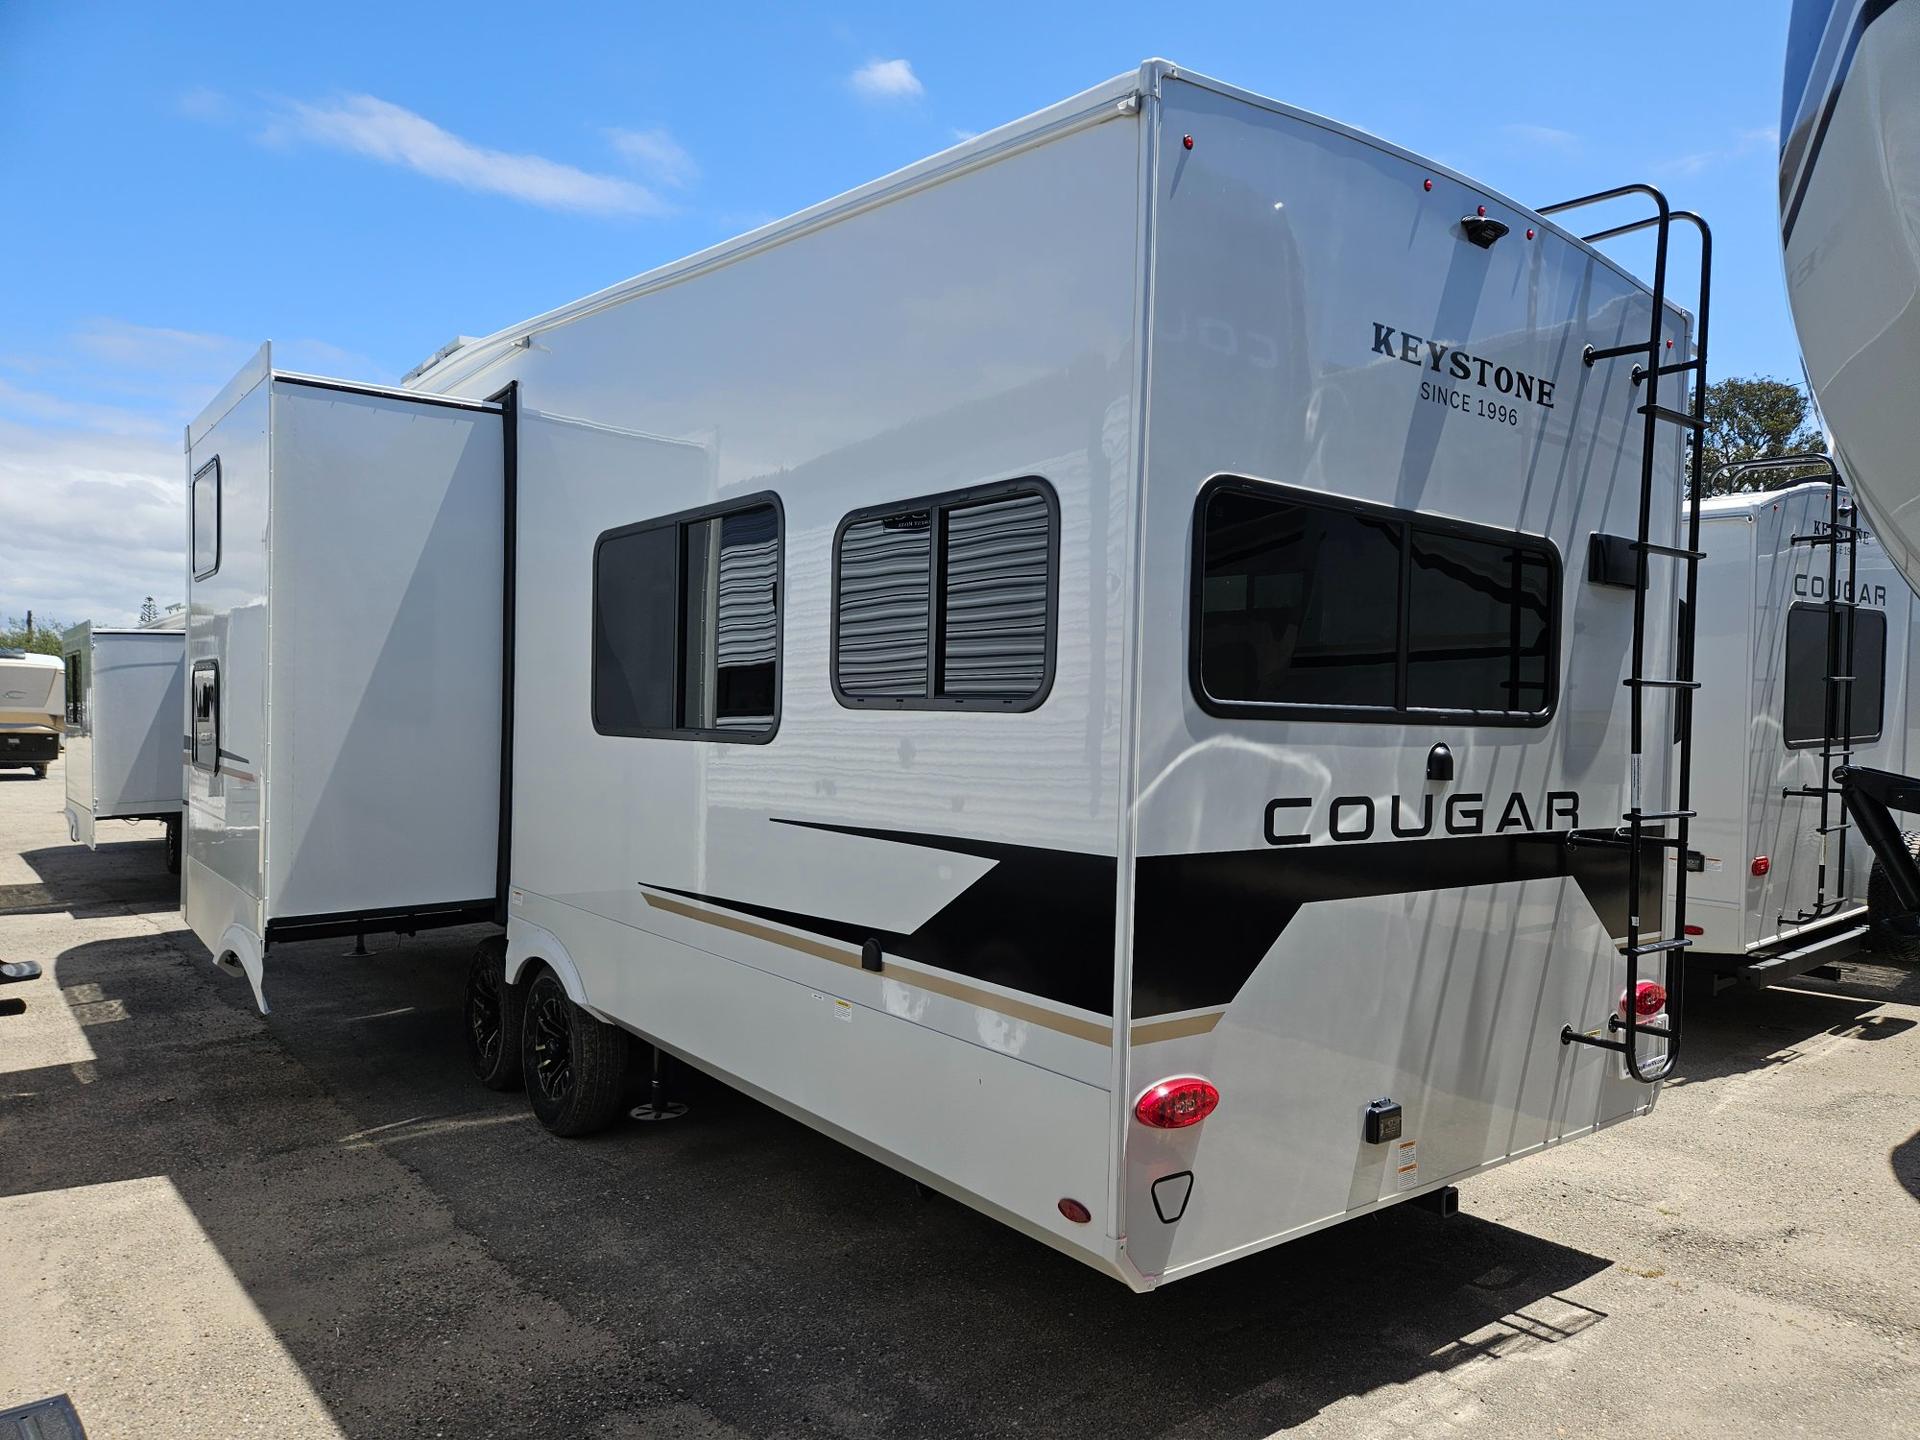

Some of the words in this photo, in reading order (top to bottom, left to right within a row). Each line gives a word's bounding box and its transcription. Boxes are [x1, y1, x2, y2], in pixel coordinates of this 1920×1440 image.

[1371, 321, 1556, 409] KEYSTONE
[1420, 381, 1471, 413] SINCE
[1477, 399, 1518, 426] 1996
[1813, 520, 1870, 545] KESNE
[1263, 790, 1580, 846] COUGAR
